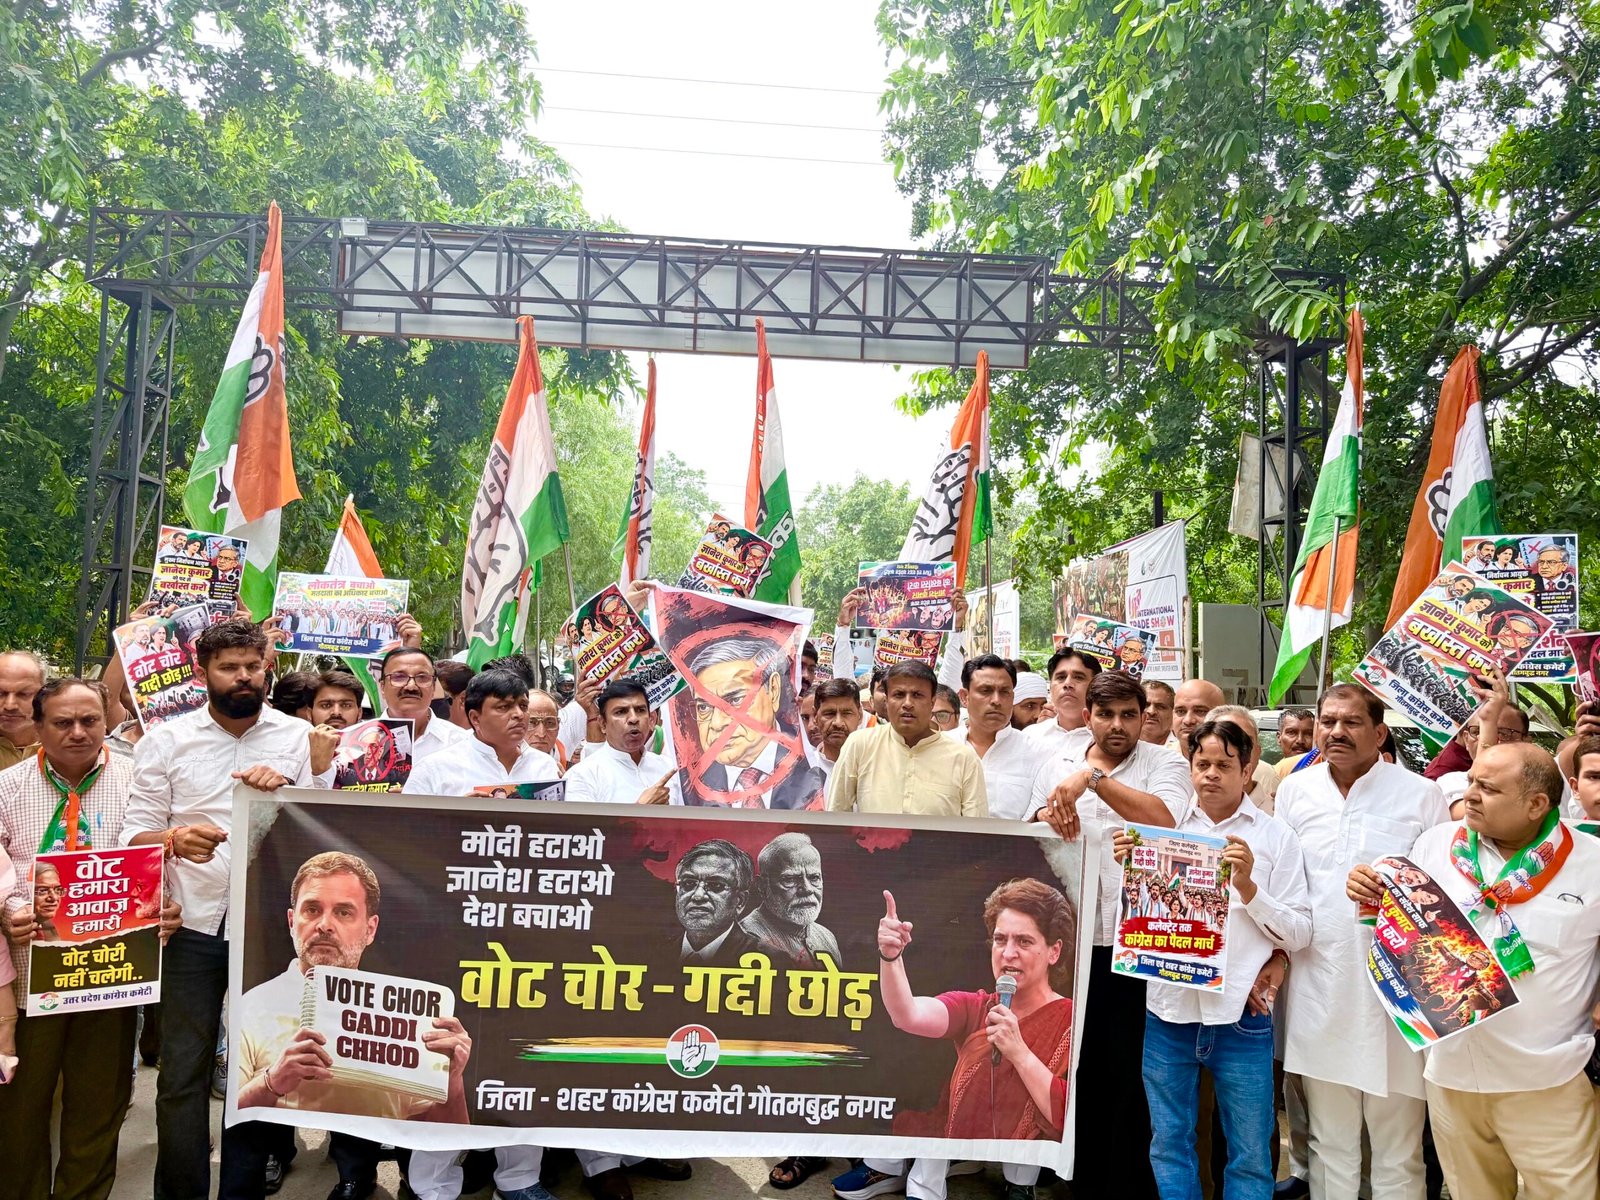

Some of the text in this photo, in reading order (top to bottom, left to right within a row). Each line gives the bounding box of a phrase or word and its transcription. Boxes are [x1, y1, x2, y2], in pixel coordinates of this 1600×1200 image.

[1137, 604, 1174, 618] INTERNATIONAL
[1150, 614, 1174, 628] SHOW
[1419, 600, 1457, 628] ज्ञानेश
[1453, 620, 1485, 642] कुमार
[1408, 618, 1468, 660] बर्खास्त
[134, 651, 181, 680] वोट चोर
[139, 672, 162, 693] गद्दी
[161, 668, 182, 686] छोड़
[1388, 679, 1453, 730] जिला कांग्रेस कमेटी
[461, 824, 605, 860] मोदी हटाओ
[76, 854, 124, 880] वोट
[446, 860, 614, 897] ज्ञानेश हटाओ
[68, 877, 130, 899] हमारा
[72, 914, 122, 935] हमारी
[462, 895, 594, 932] देश बचाओ
[1148, 919, 1192, 934] कलेक्ट्रेट तक
[1388, 902, 1415, 934] कुमार
[1124, 931, 1215, 950] कांग्रेस का पैदल मार्च
[1382, 925, 1408, 950] करो
[62, 942, 127, 968] वोट चोरी
[1140, 955, 1155, 966] जिला
[1197, 965, 1213, 978] कमेटी
[53, 967, 89, 988] नहीं
[459, 942, 554, 1009] वोट
[562, 945, 648, 1012] चोर
[682, 951, 777, 1016] गद्दी
[784, 952, 878, 1032] छोड़
[1390, 977, 1408, 998] कमेटी
[80, 992, 101, 1004] प्रदेश
[102, 988, 130, 1002] कांग्रेस
[130, 986, 152, 998] कमेटी
[325, 974, 442, 1018] VOTE CHOR
[341, 1009, 418, 1042] GADDI
[336, 1035, 420, 1069] CHHOD
[476, 1079, 537, 1112] जिला
[557, 1086, 608, 1114] शहर
[611, 1083, 679, 1116] कांग्रेस
[682, 1084, 744, 1116] कमेटी
[748, 1084, 840, 1124] गौतमबुद्ध
[846, 1096, 896, 1121] नगर
